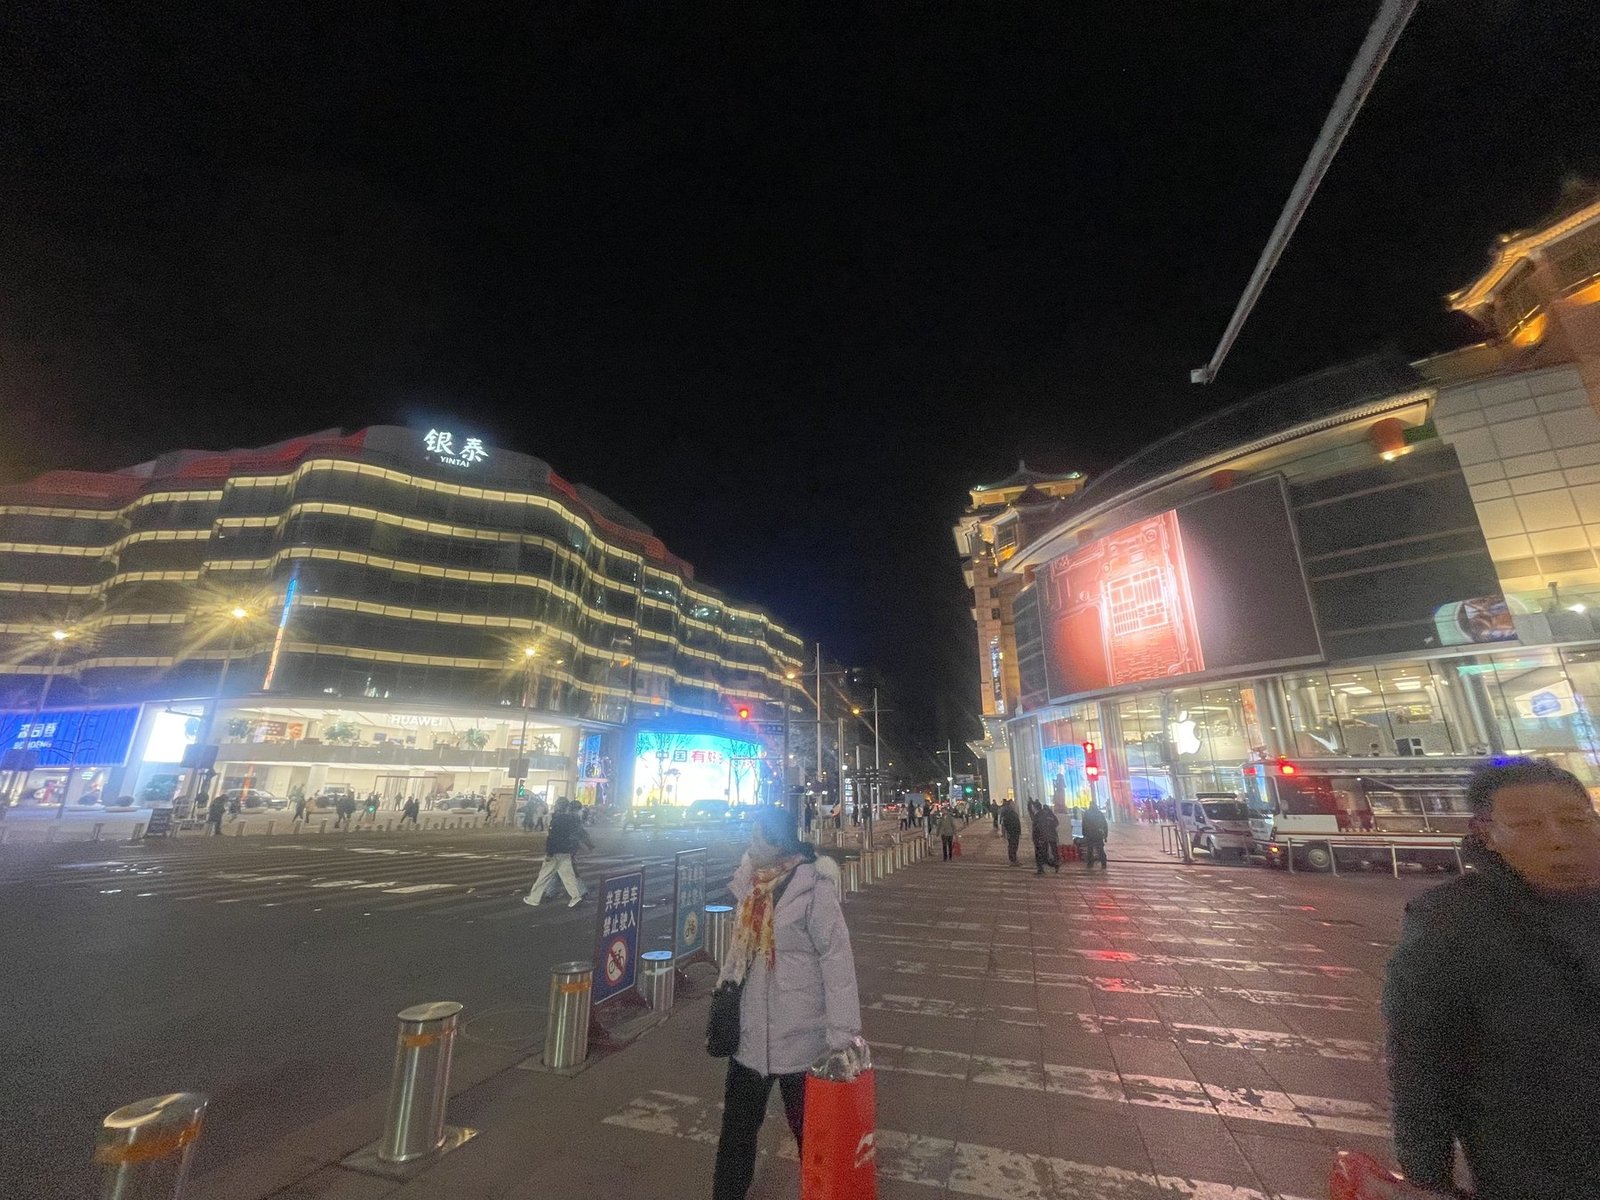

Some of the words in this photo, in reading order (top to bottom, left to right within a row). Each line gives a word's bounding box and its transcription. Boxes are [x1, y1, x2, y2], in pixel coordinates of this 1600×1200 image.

[423, 428, 489, 462] 银泰
[440, 456, 470, 468] YINTAI
[390, 714, 442, 726] HUAWEI
[605, 886, 638, 912] 共享单车
[602, 910, 636, 937] 禁止驶入
